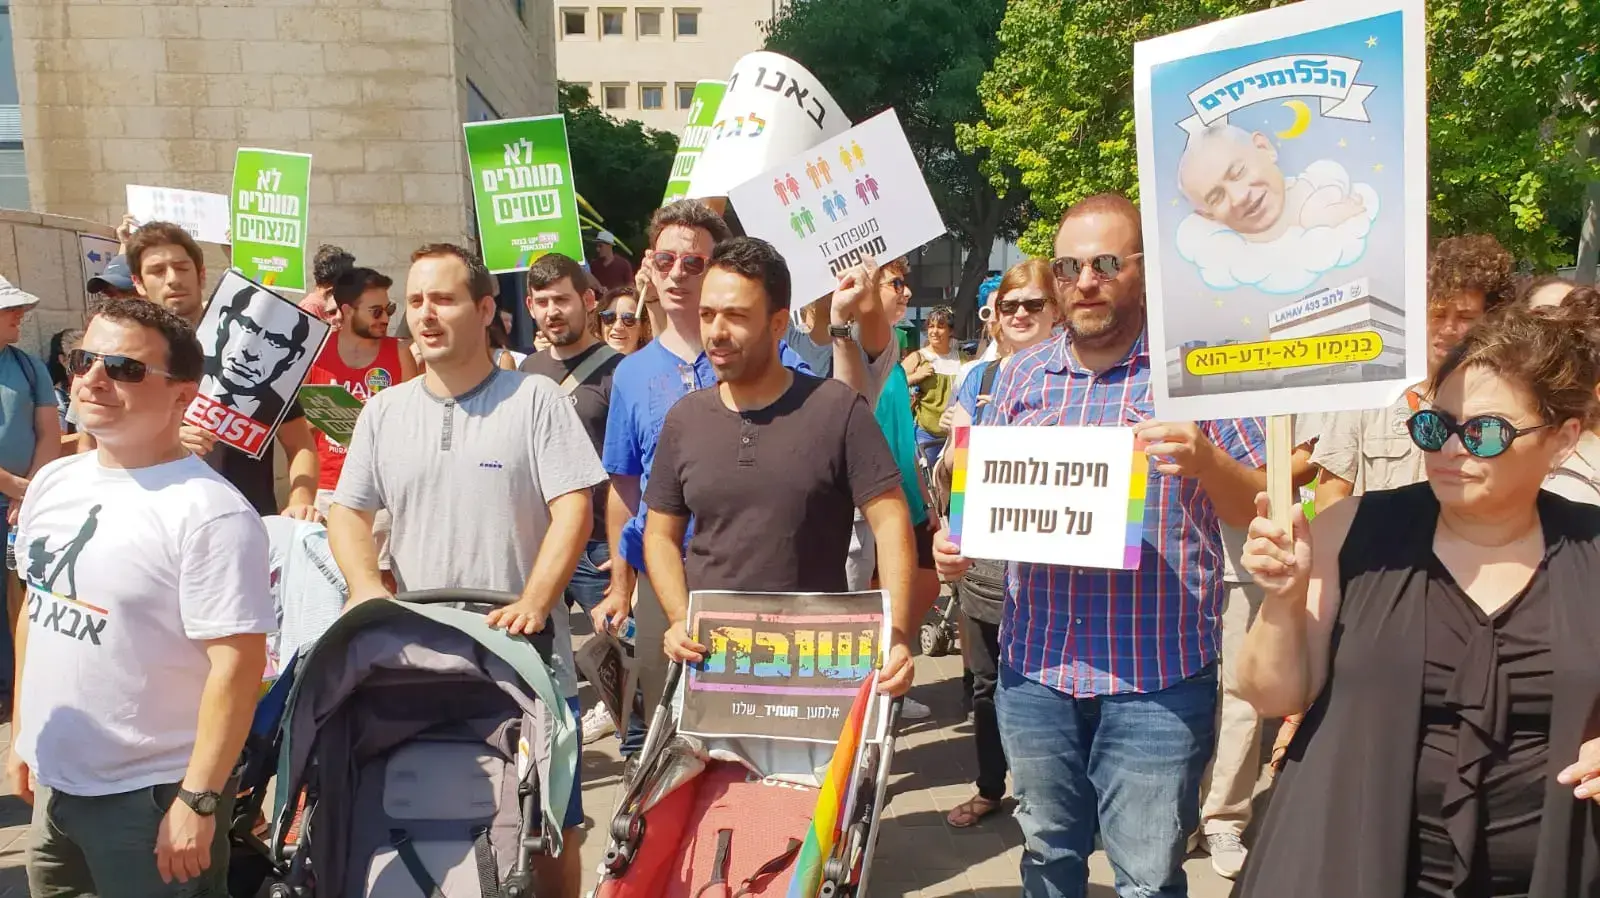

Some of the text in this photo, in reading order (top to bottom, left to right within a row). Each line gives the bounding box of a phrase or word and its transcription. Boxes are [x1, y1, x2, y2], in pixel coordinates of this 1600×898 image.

[754, 66, 826, 130] באנו
[1198, 59, 1347, 110] הכלומניקים
[503, 137, 533, 166] לא
[256, 168, 282, 192] לא
[482, 163, 563, 192] מוותרים
[238, 189, 300, 216] מוותרים
[497, 193, 556, 220] שווים
[240, 217, 297, 243] מנצחים
[818, 217, 880, 258] משפחה זו
[1322, 289, 1343, 306] להב
[1275, 306, 1303, 322] LAHAV
[982, 457, 1109, 488] חיפה נלחמת
[989, 506, 1093, 536] על שיוויון
[43, 602, 107, 645] אבא
[704, 626, 874, 681] שובת
